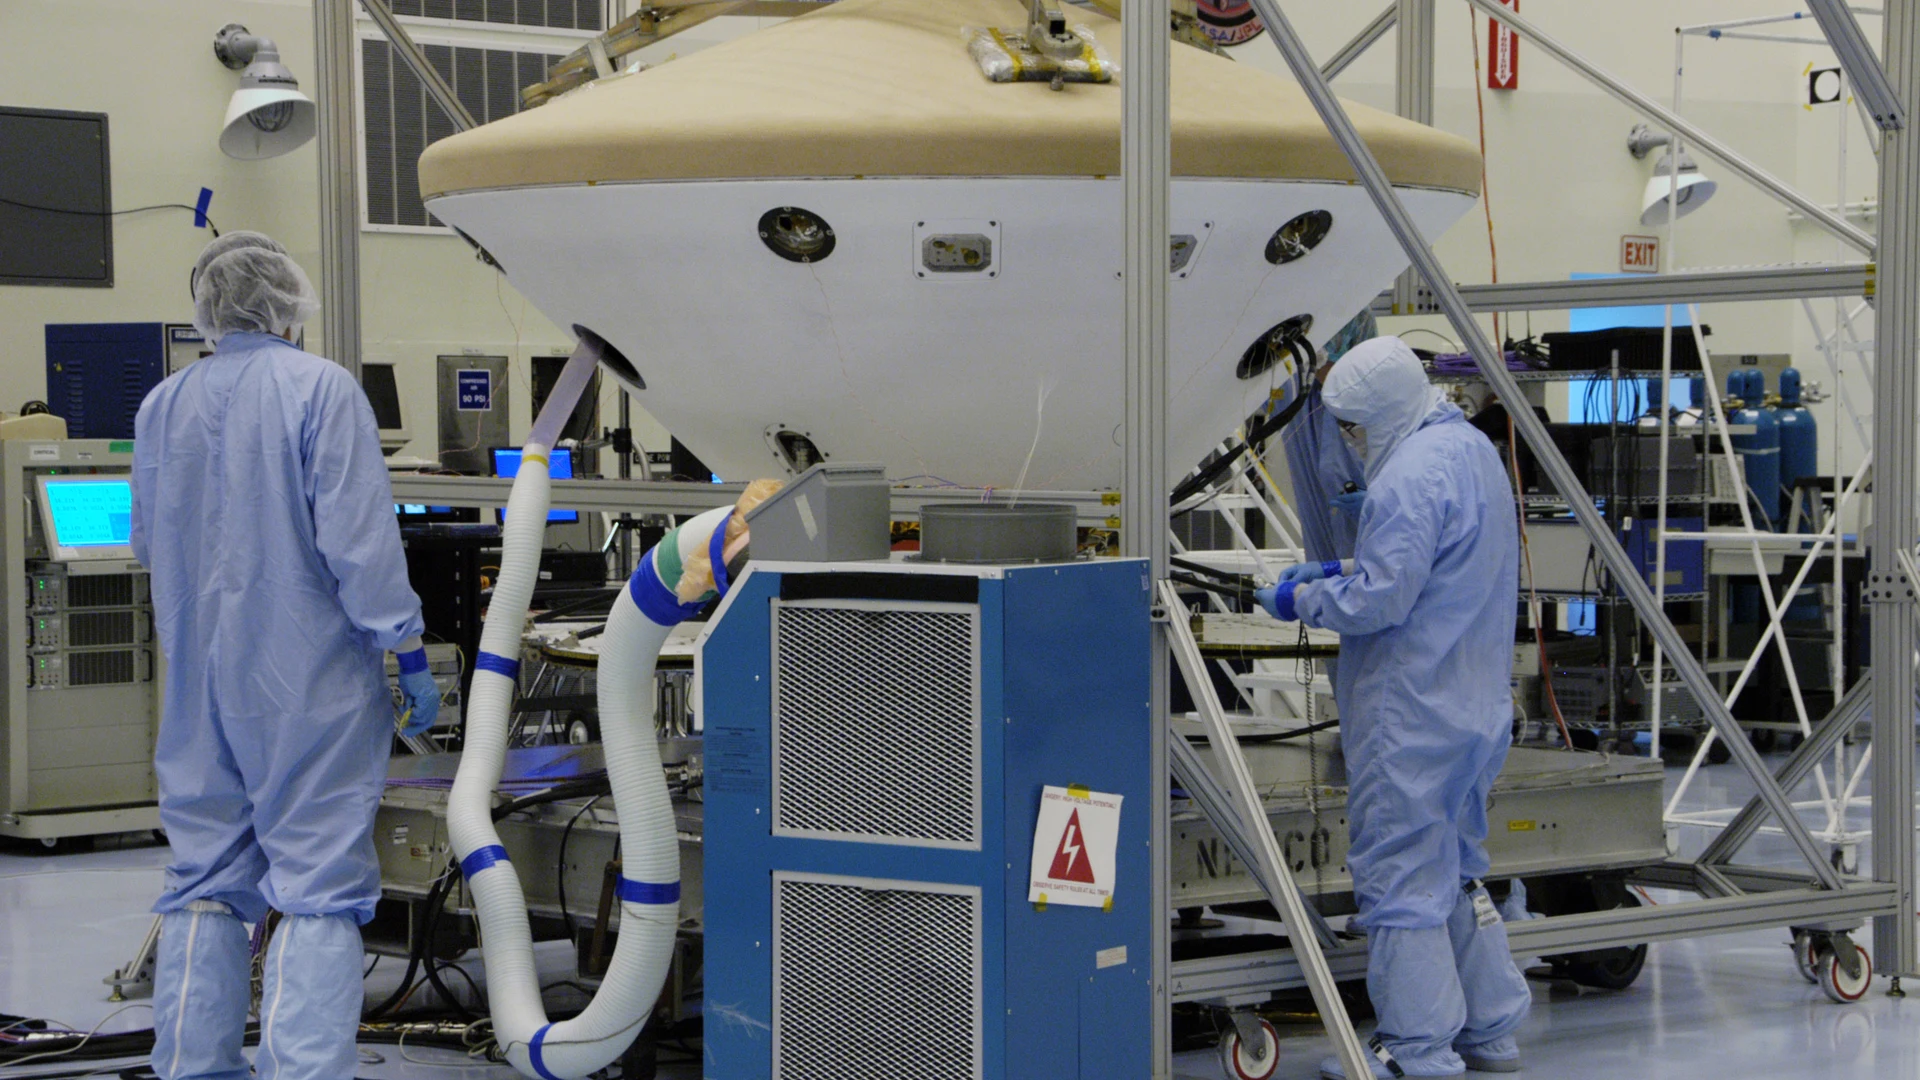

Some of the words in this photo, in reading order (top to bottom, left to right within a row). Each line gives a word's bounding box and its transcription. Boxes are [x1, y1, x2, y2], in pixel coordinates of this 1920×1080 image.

[1196, 21, 1262, 41] ASA/JPL
[1625, 242, 1656, 266] EXIT
[462, 395, 472, 403] 90
[474, 395, 486, 403] PSI
[1033, 881, 1053, 889] OBSERVE
[1157, 984, 1163, 993] A
[1176, 981, 1183, 989] A
